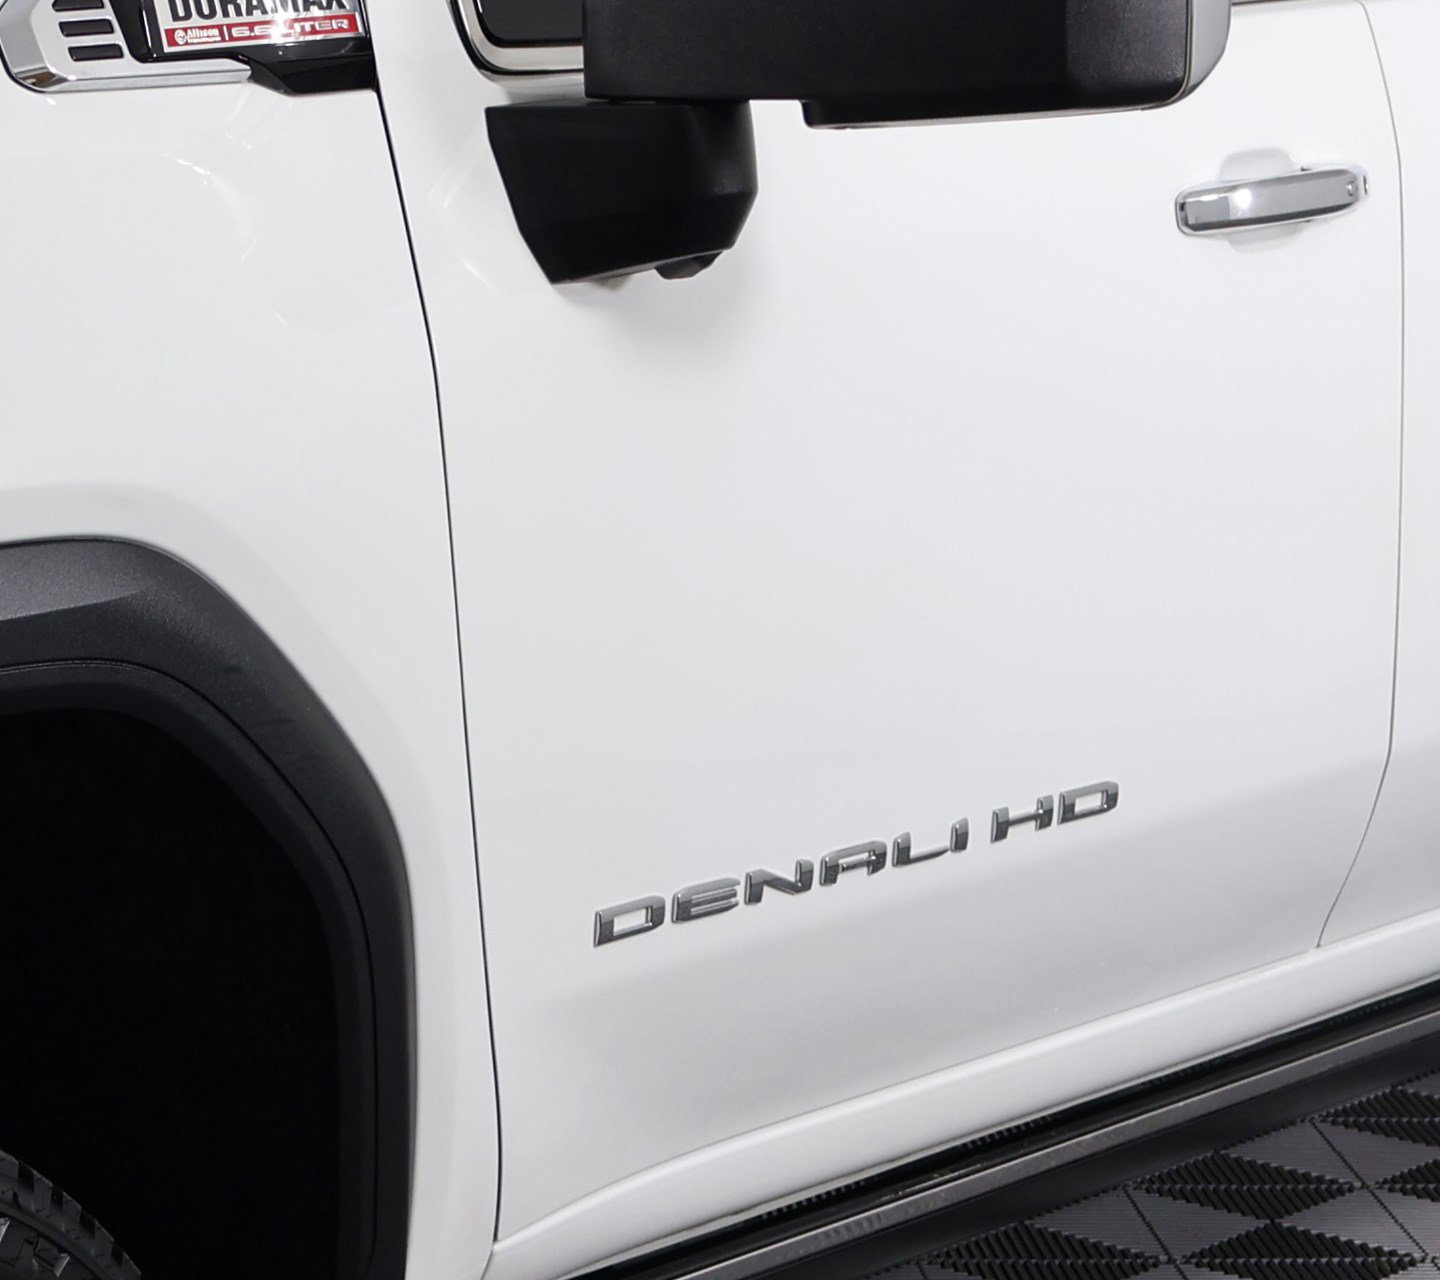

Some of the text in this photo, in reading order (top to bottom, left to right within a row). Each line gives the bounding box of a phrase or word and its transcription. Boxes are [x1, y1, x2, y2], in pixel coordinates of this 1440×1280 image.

[186, 28, 220, 39] Allison
[593, 780, 1119, 947] DENALI HD
